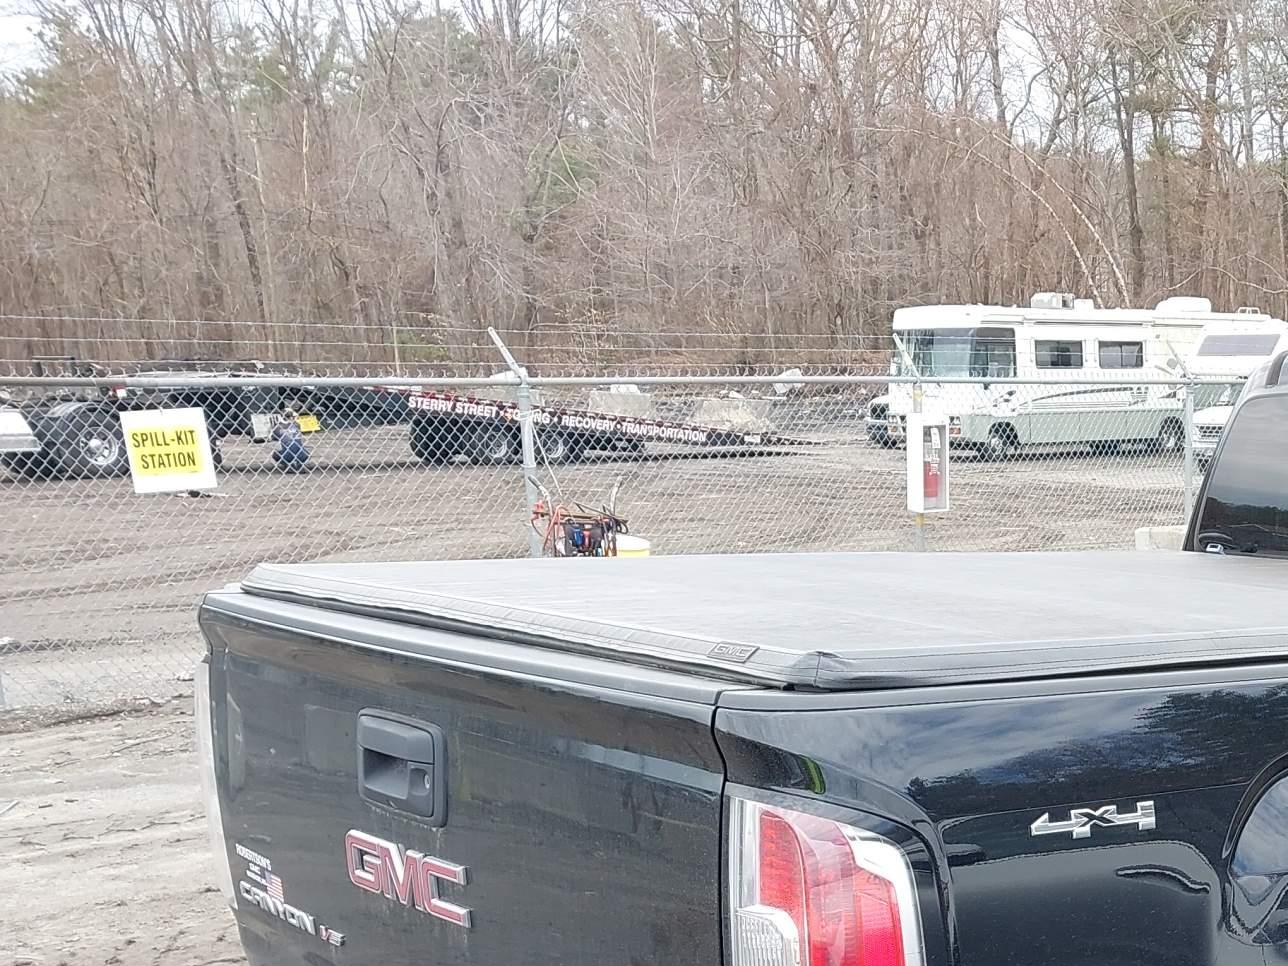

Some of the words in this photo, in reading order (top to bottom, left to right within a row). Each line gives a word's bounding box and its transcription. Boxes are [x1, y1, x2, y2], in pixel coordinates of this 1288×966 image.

[408, 395, 453, 412] STERRY
[455, 402, 497, 417] STREET
[505, 408, 550, 424] TONG
[561, 415, 615, 431] RECOVERY
[621, 421, 707, 441] TRANSPORTATION
[131, 429, 196, 448] SPILL-KIT
[140, 451, 197, 469] STATION
[714, 644, 754, 657] GMC
[345, 829, 472, 928] GMC
[240, 880, 317, 936] CANYON
